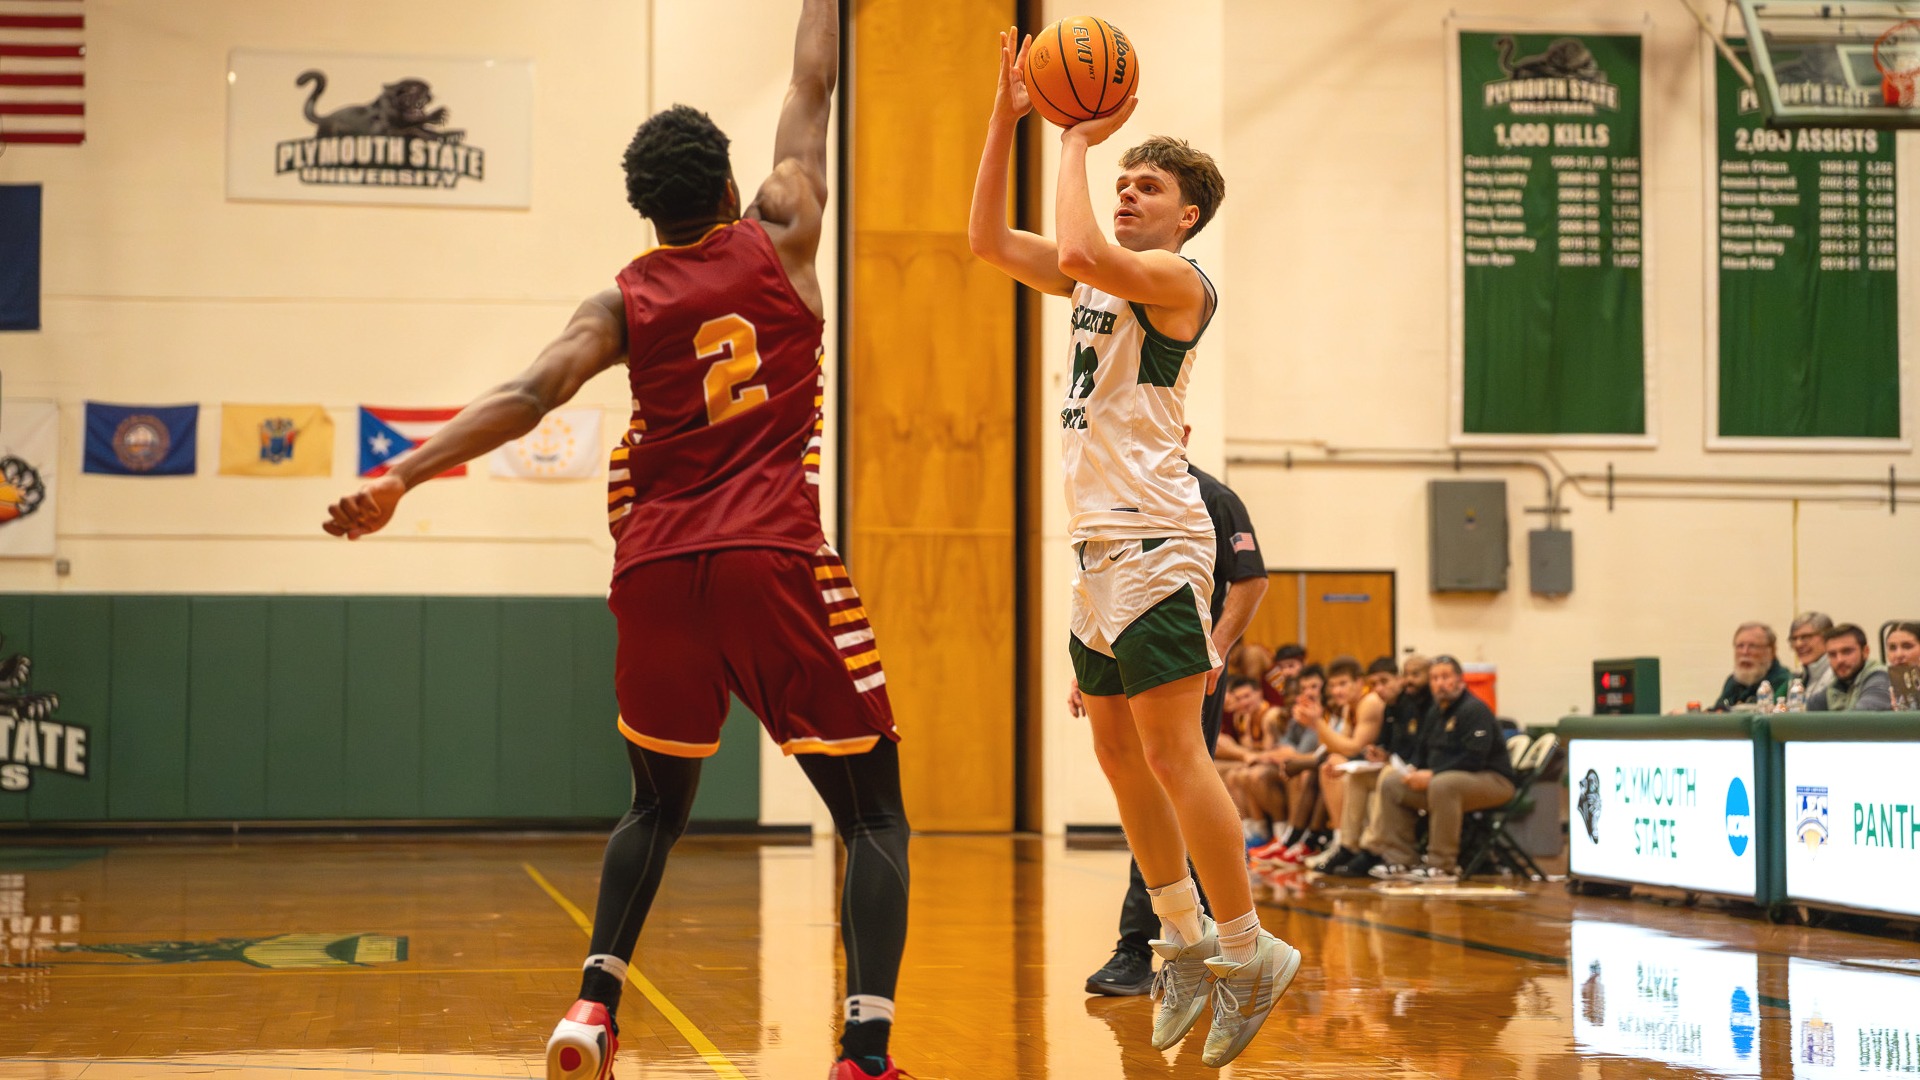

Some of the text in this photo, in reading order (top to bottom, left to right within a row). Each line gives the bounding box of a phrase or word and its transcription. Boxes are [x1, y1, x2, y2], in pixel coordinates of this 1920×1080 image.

[1485, 78, 1618, 109] PLYMOUTH STATE
[1494, 123, 1610, 149] 1,000 KILLS
[1796, 128, 1878, 153] ASSISTS
[280, 135, 481, 177] PLYMOUTH STATE
[302, 167, 457, 188] UNIVERSITY
[693, 313, 762, 426] 2
[1616, 766, 1696, 806] PLYMOUTH
[1634, 817, 1677, 858] STATE
